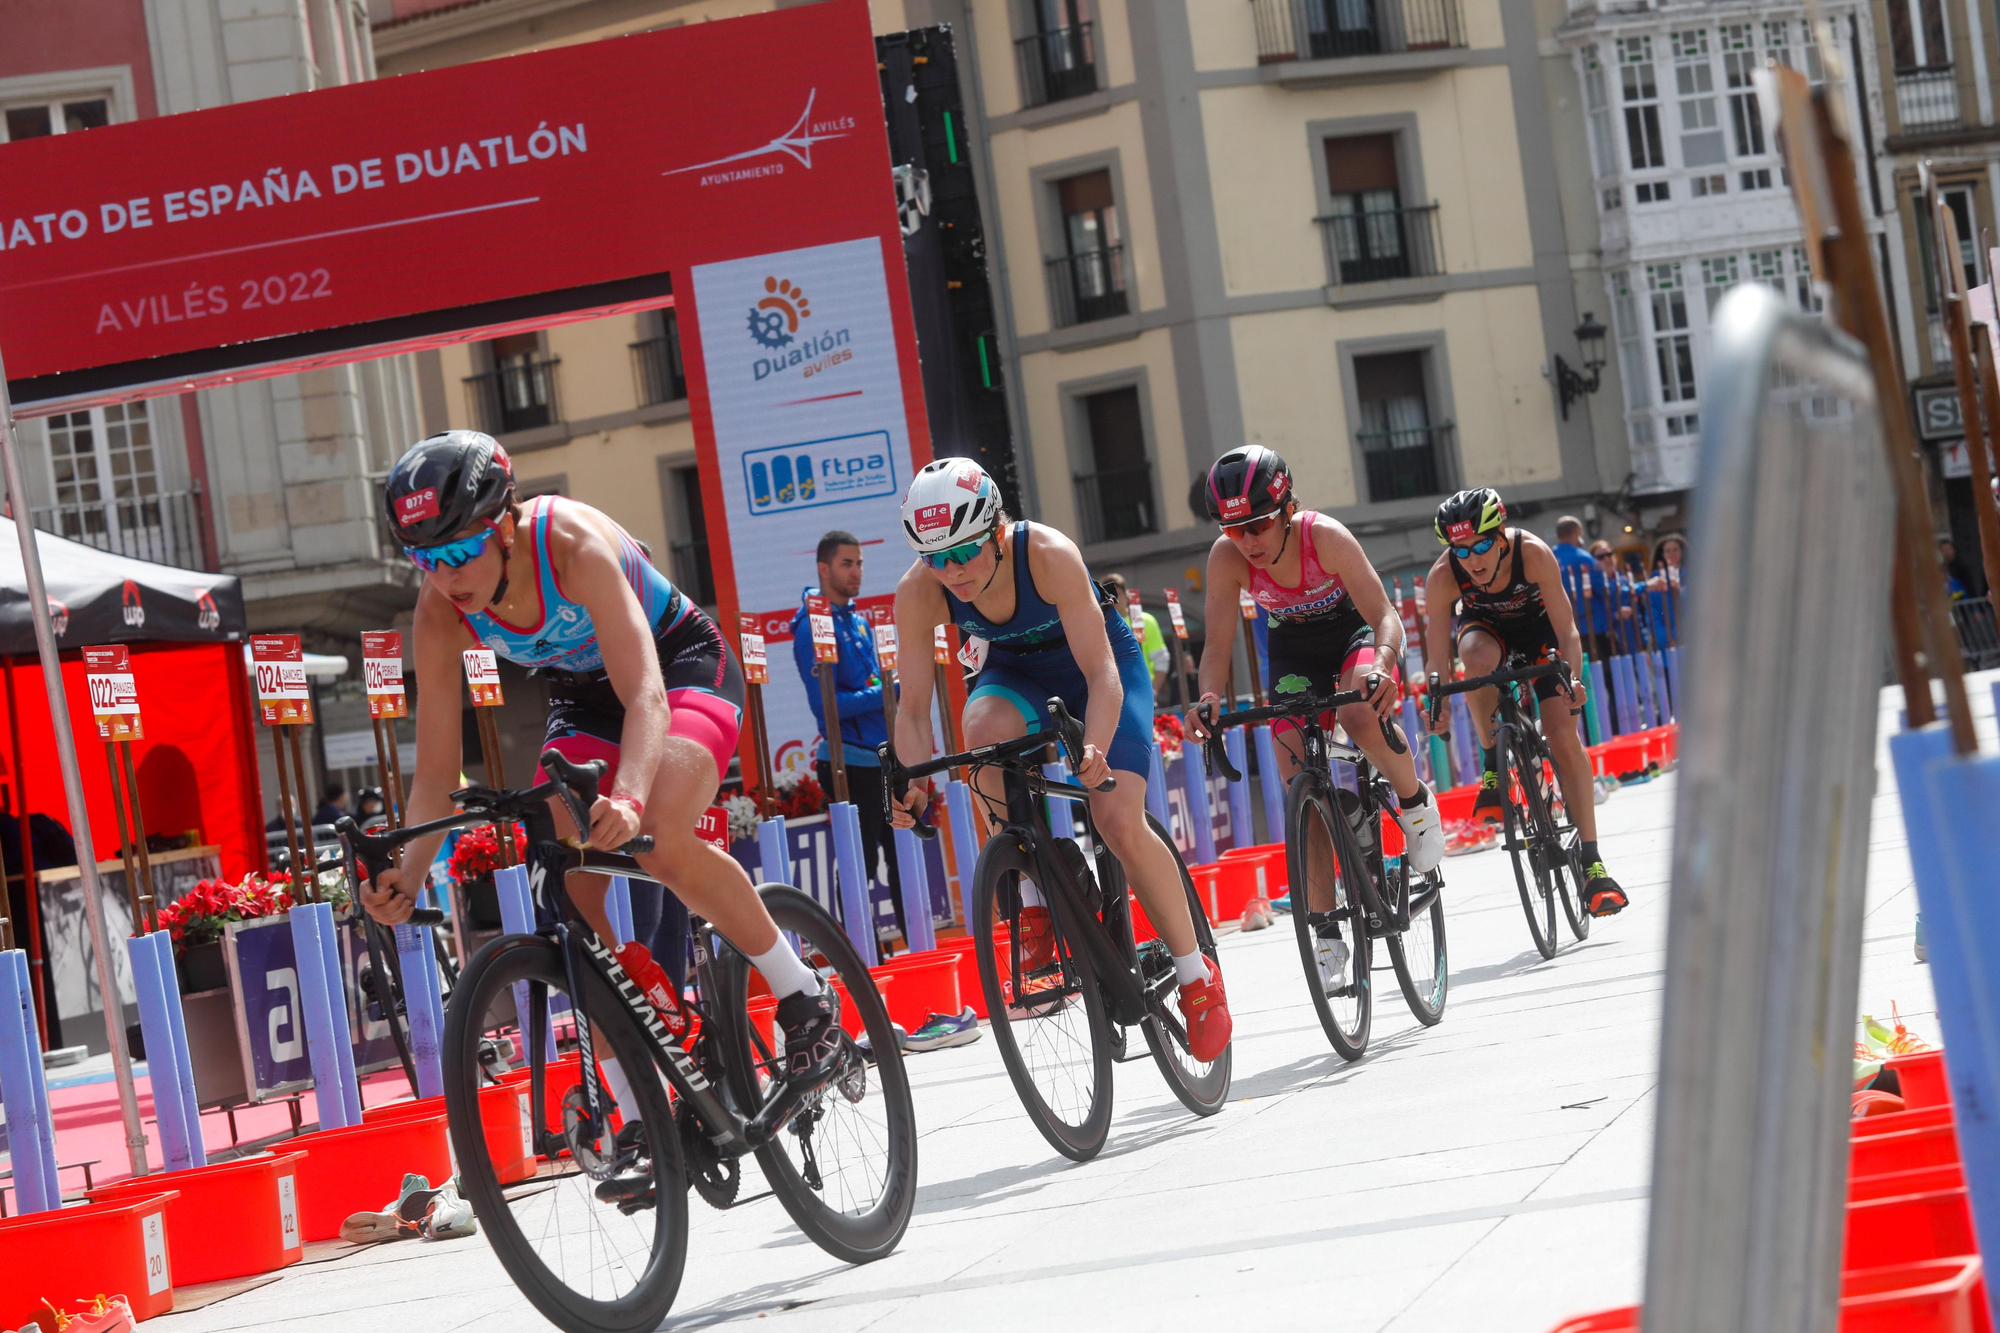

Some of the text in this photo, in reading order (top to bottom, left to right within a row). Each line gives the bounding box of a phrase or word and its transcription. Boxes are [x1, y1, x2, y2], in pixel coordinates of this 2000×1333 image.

[813, 117, 855, 133] AVILÉS
[101, 196, 153, 234] DE
[164, 167, 321, 223] ESPAÑA
[332, 158, 385, 194] DE
[396, 121, 587, 184] DUATLÓN
[701, 163, 784, 187] AYUNTAMIENTO
[96, 268, 332, 335] AVILÉS 2022
[753, 328, 850, 381] Duatlón
[822, 454, 884, 477] ftpa
[406, 494, 423, 509] 077
[923, 508, 937, 518] 007
[1272, 587, 1342, 614] SALTOKI
[366, 661, 383, 689] 026
[465, 653, 483, 678] 028
[257, 665, 284, 693] 024
[91, 678, 116, 708] 022
[583, 932, 710, 1092] SPECIALIZED
[284, 1213, 294, 1234] 22
[150, 1254, 162, 1278] 20
